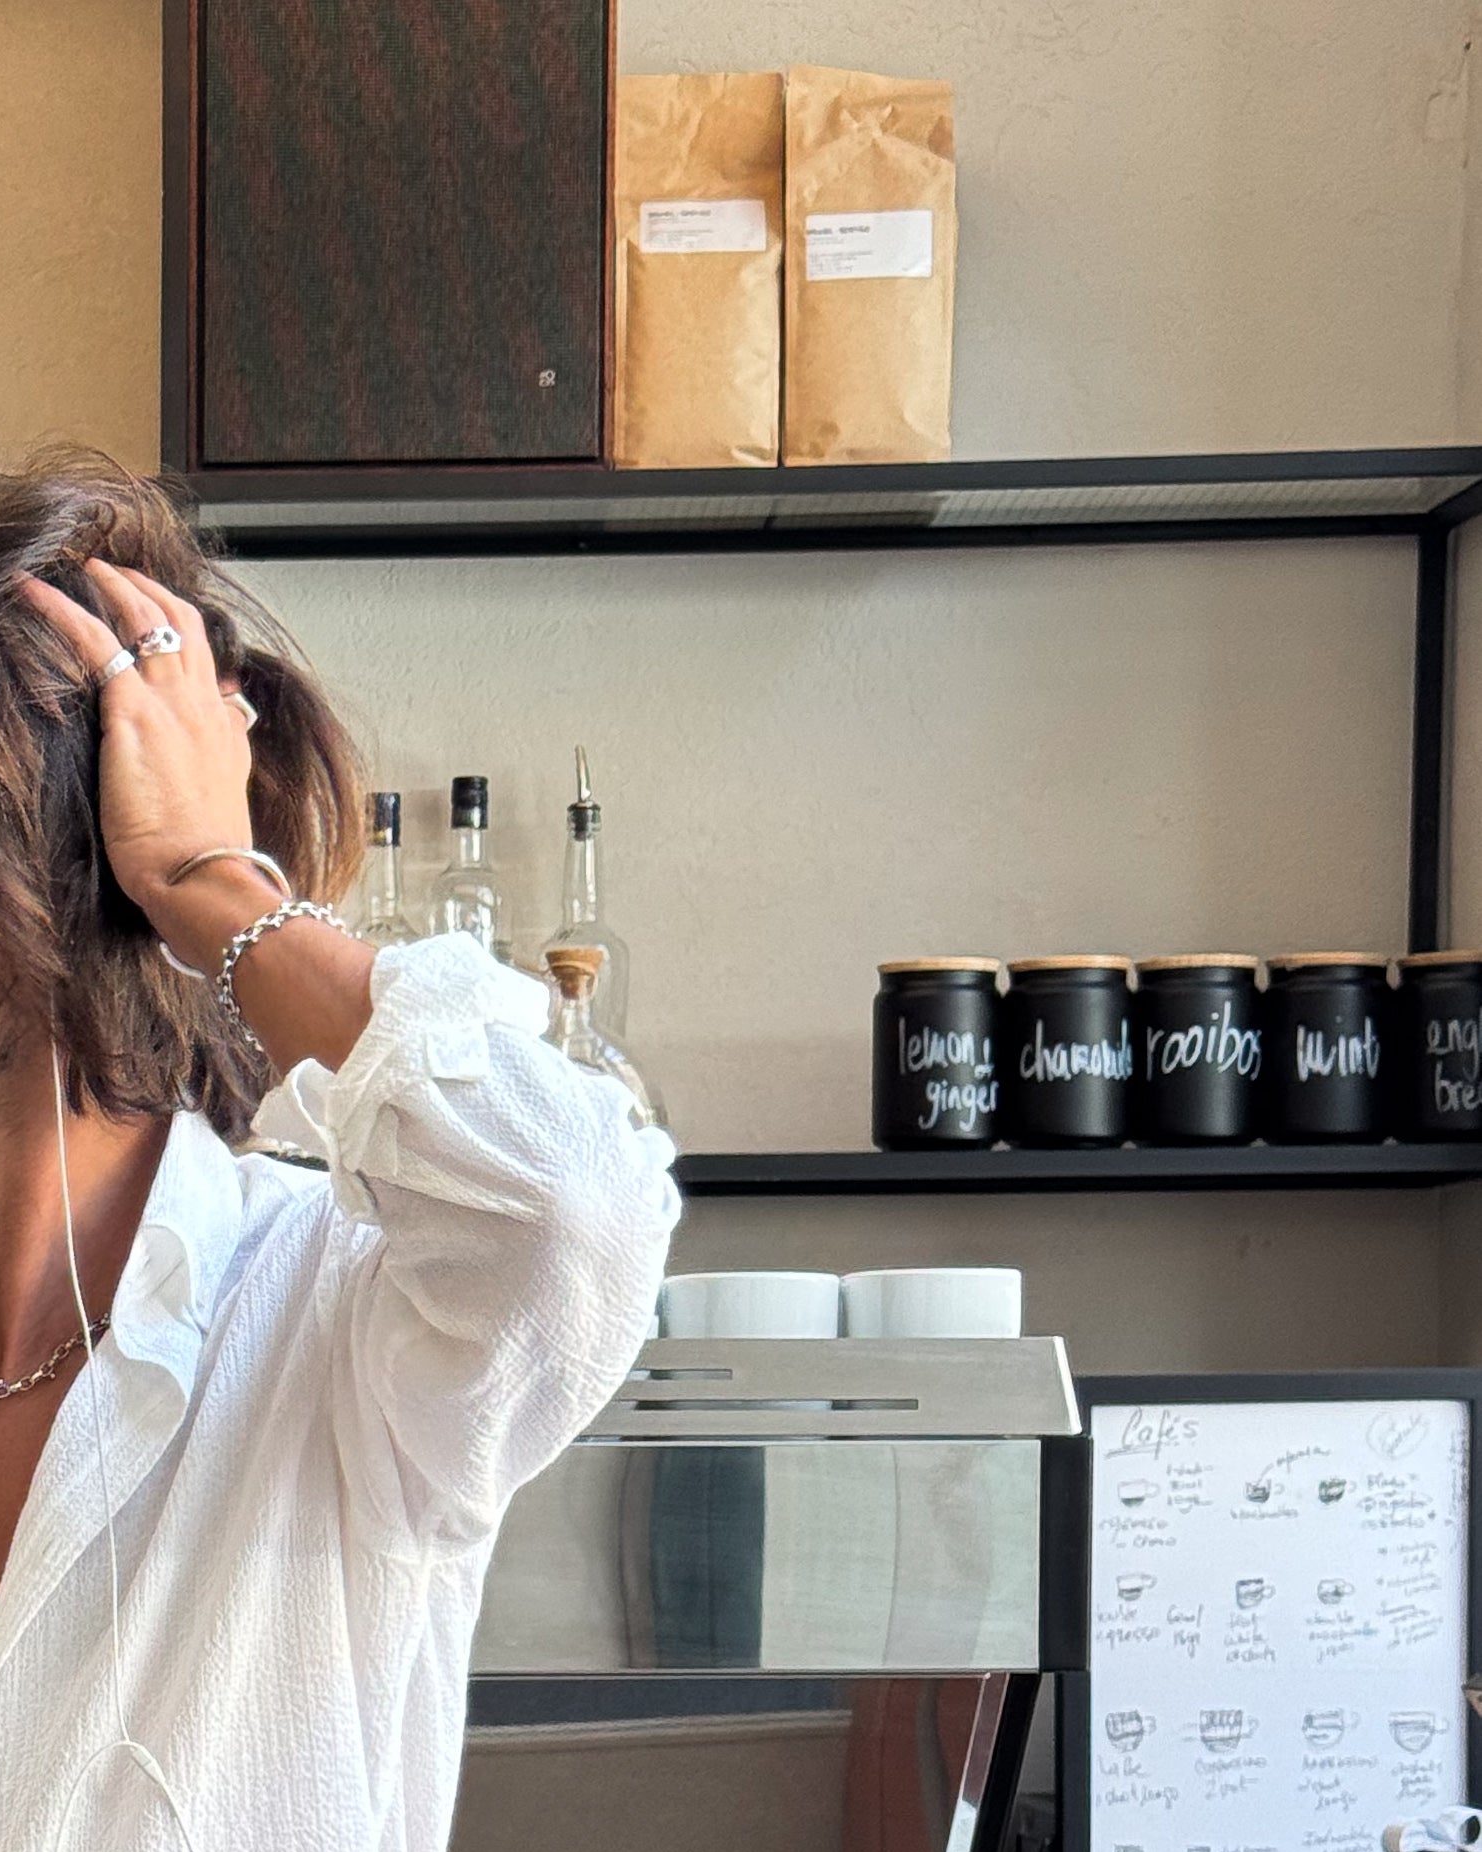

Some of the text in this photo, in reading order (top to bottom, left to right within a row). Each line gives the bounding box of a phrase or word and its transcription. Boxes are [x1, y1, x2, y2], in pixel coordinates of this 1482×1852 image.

[899, 1016, 975, 1073] lemon
[1146, 1001, 1262, 1082] rooibos
[918, 1079, 999, 1131] ginger
